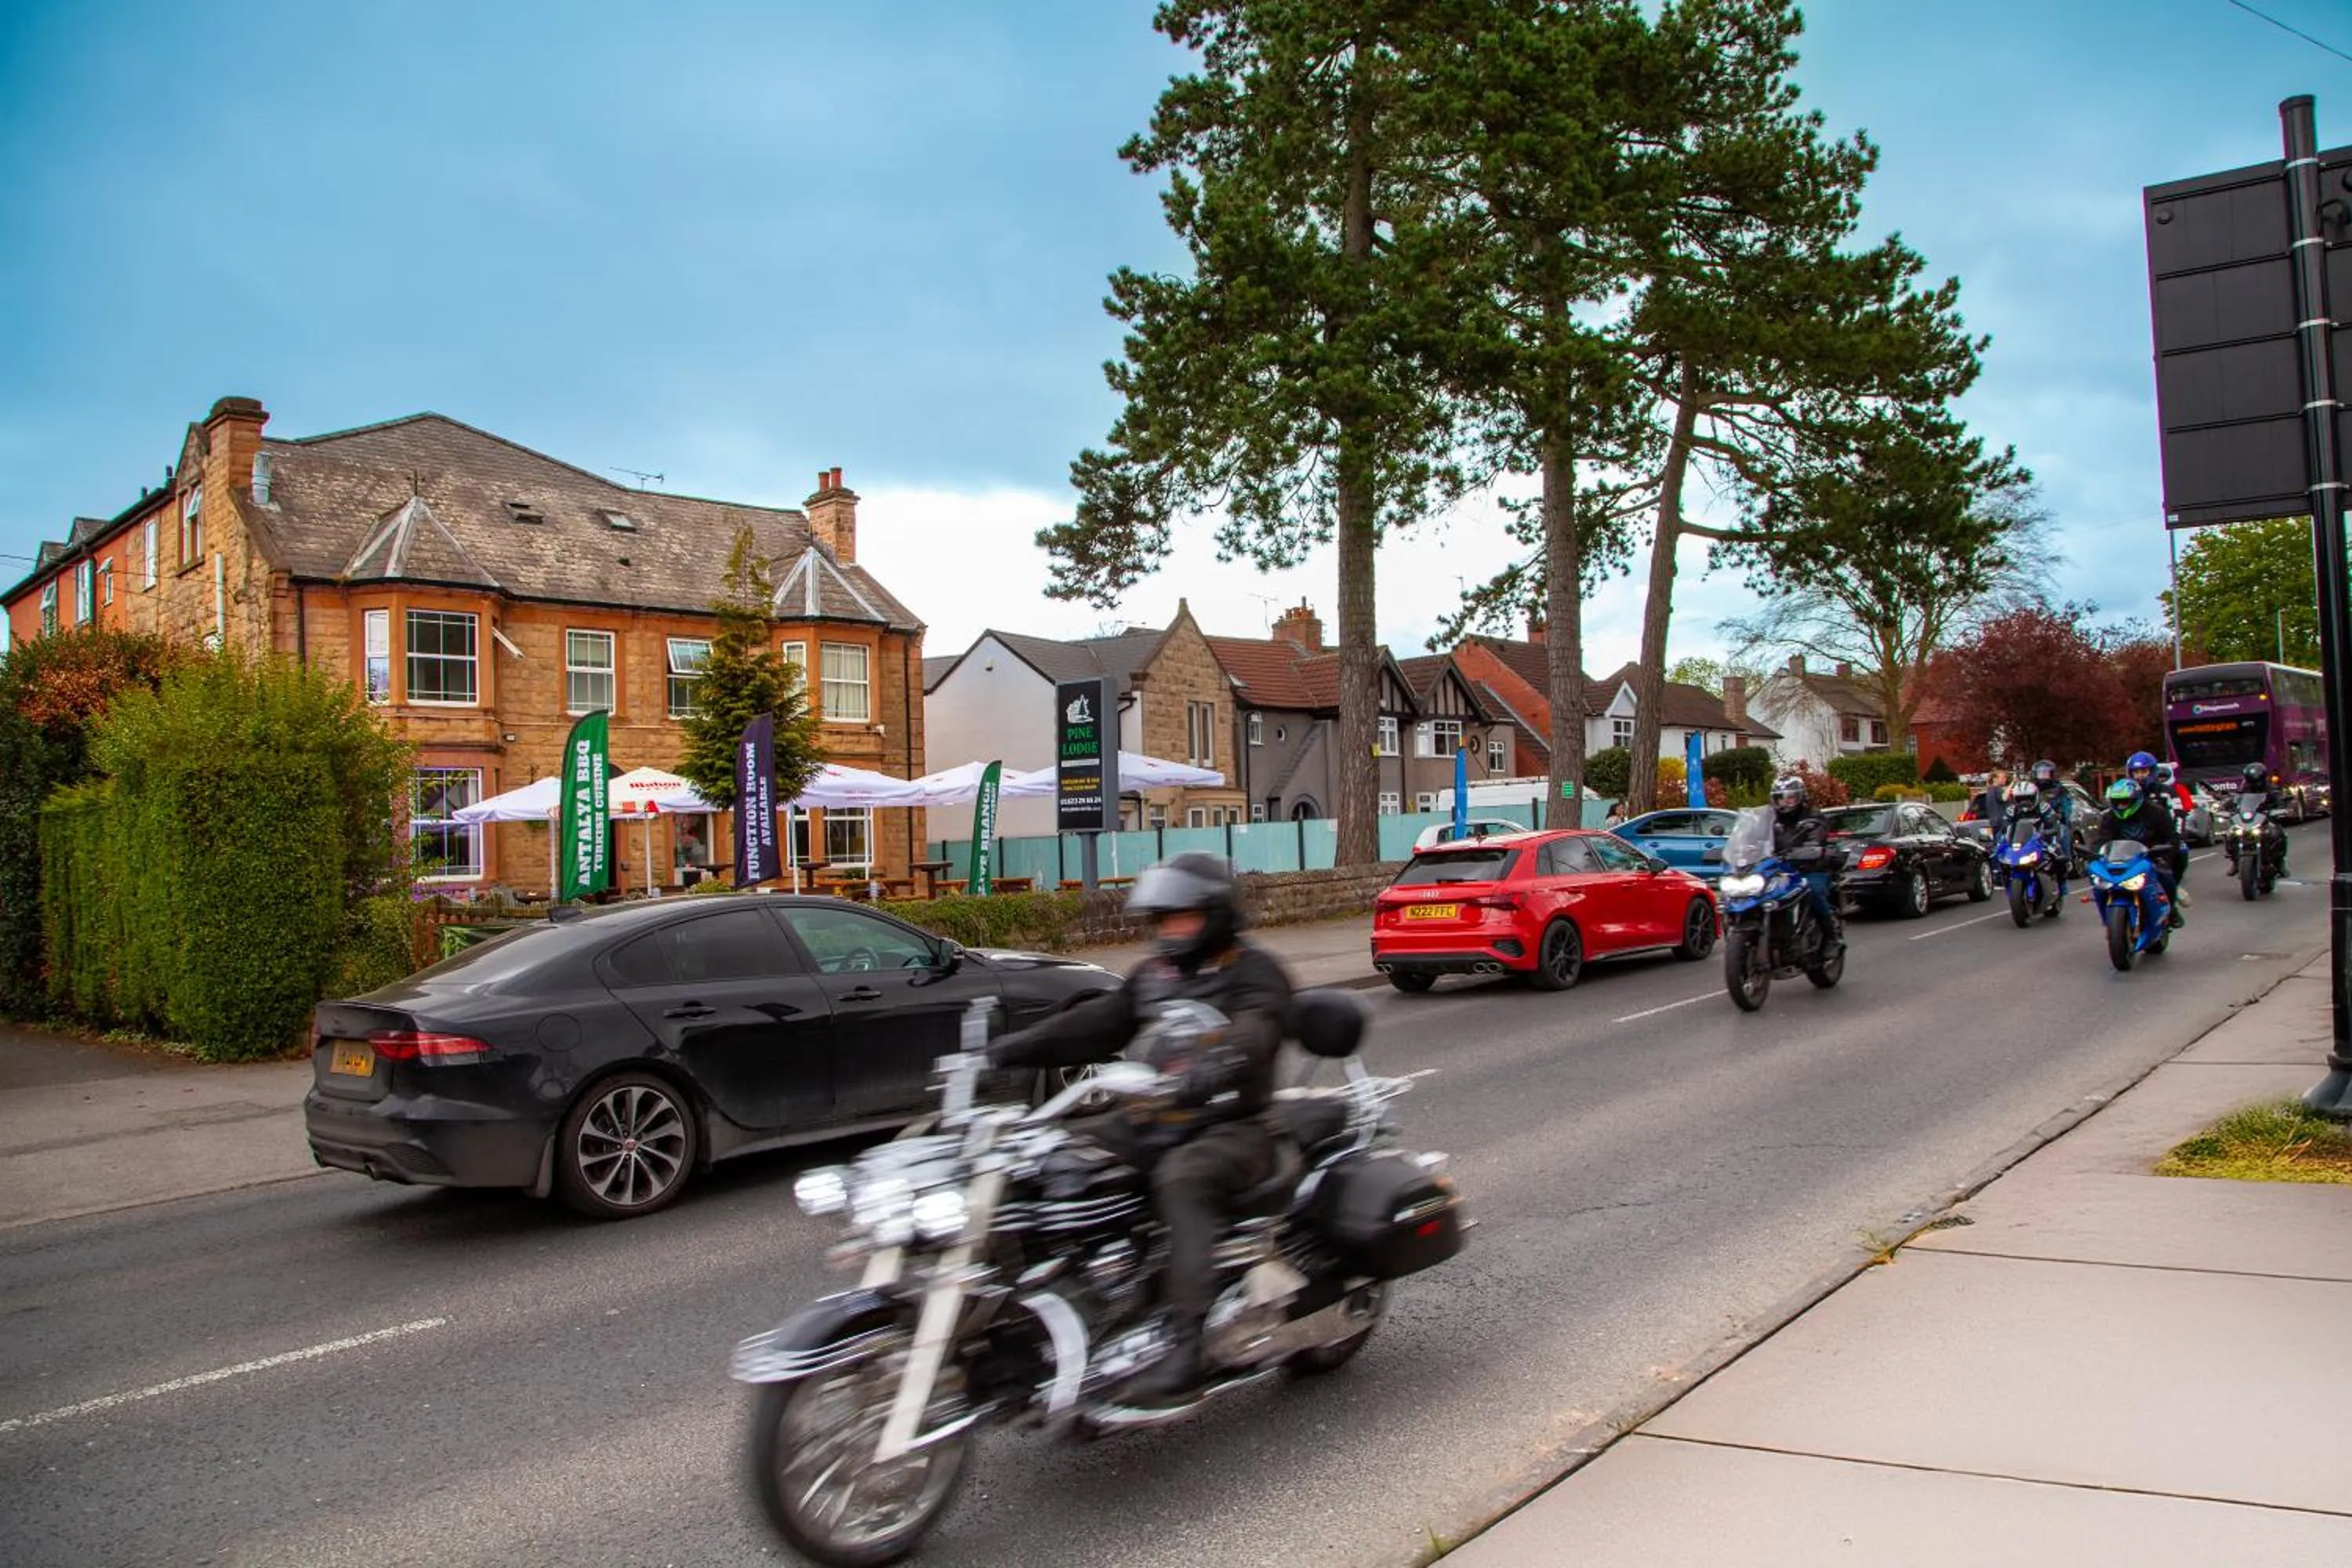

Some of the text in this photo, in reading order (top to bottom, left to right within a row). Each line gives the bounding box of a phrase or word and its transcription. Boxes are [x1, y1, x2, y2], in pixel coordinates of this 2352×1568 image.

[1062, 741, 1099, 756] LODGE
[1067, 726, 1094, 739] PINE
[576, 739, 591, 886] ANTALYA BBQ
[592, 753, 604, 873] TURKISH CUISINE
[746, 742, 760, 880] FUNCTION ROOM
[759, 775, 771, 847] AVAILABLE
[981, 782, 991, 851] BRANCH
